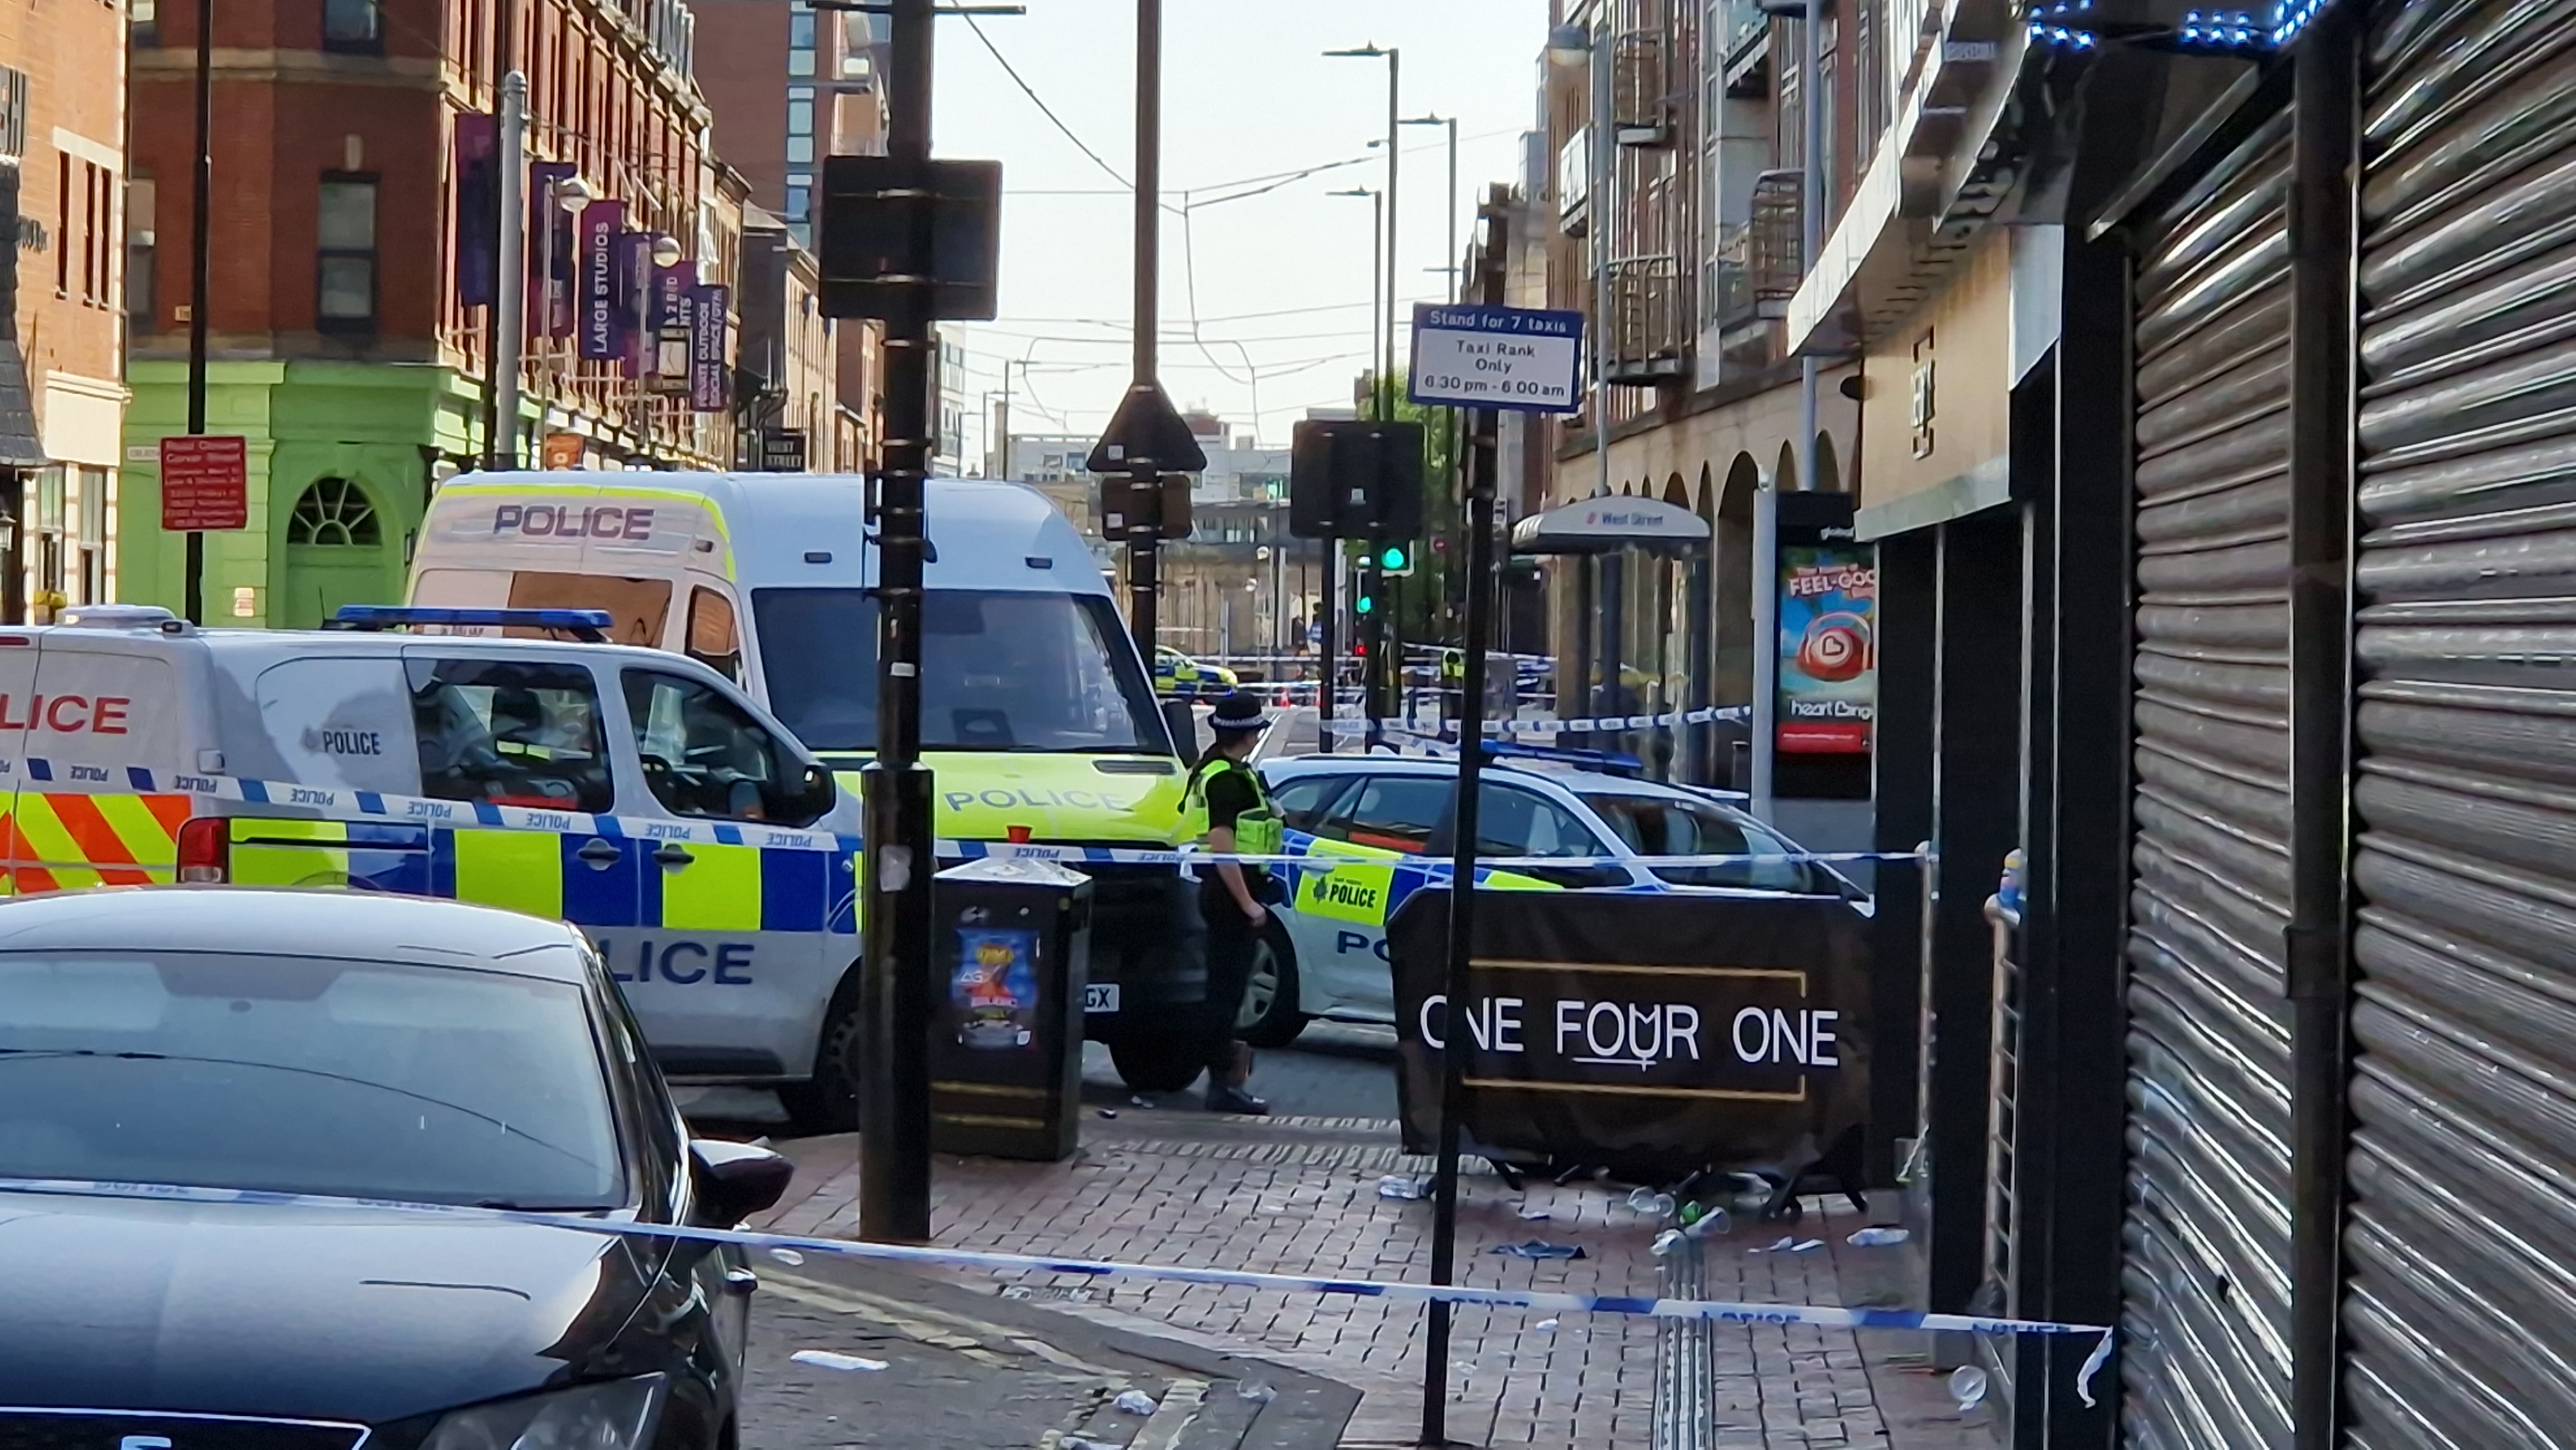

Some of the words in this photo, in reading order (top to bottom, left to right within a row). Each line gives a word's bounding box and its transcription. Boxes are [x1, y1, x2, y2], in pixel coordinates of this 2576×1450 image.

[594, 222, 609, 294] STUDIOS
[594, 299, 609, 353] LARGE
[1430, 310, 1476, 326] Stand
[1482, 315, 1505, 329] for
[1511, 315, 1522, 329] 7
[1528, 317, 1567, 333] taxis
[1456, 339, 1490, 353] Taxi
[1497, 342, 1536, 357] Rank
[1475, 357, 1513, 374] Only
[1464, 380, 1488, 393] pm
[1541, 385, 1565, 397] am
[493, 504, 656, 541] POLICE
[1602, 513, 1629, 525] West
[1631, 513, 1663, 525] Street
[0, 693, 131, 735] LICE
[1791, 699, 1833, 716] heart
[323, 731, 383, 756] POLICE
[70, 765, 109, 782] POLICE
[174, 775, 218, 793] POLICE
[290, 787, 336, 807] POLICE
[943, 789, 1135, 813] POLICE
[406, 800, 452, 819] POLICE
[525, 812, 571, 831] POLICE
[645, 823, 692, 840] POLICE
[767, 832, 814, 848] POLICE
[1014, 847, 1060, 859] POLICE
[1329, 883, 1377, 909] POLICE
[597, 939, 755, 984] LICE
[1086, 988, 1110, 1009] GX
[1420, 994, 1524, 1051] ONE
[1556, 1000, 1700, 1071] FOUR
[1732, 1006, 1839, 1067] ONE
